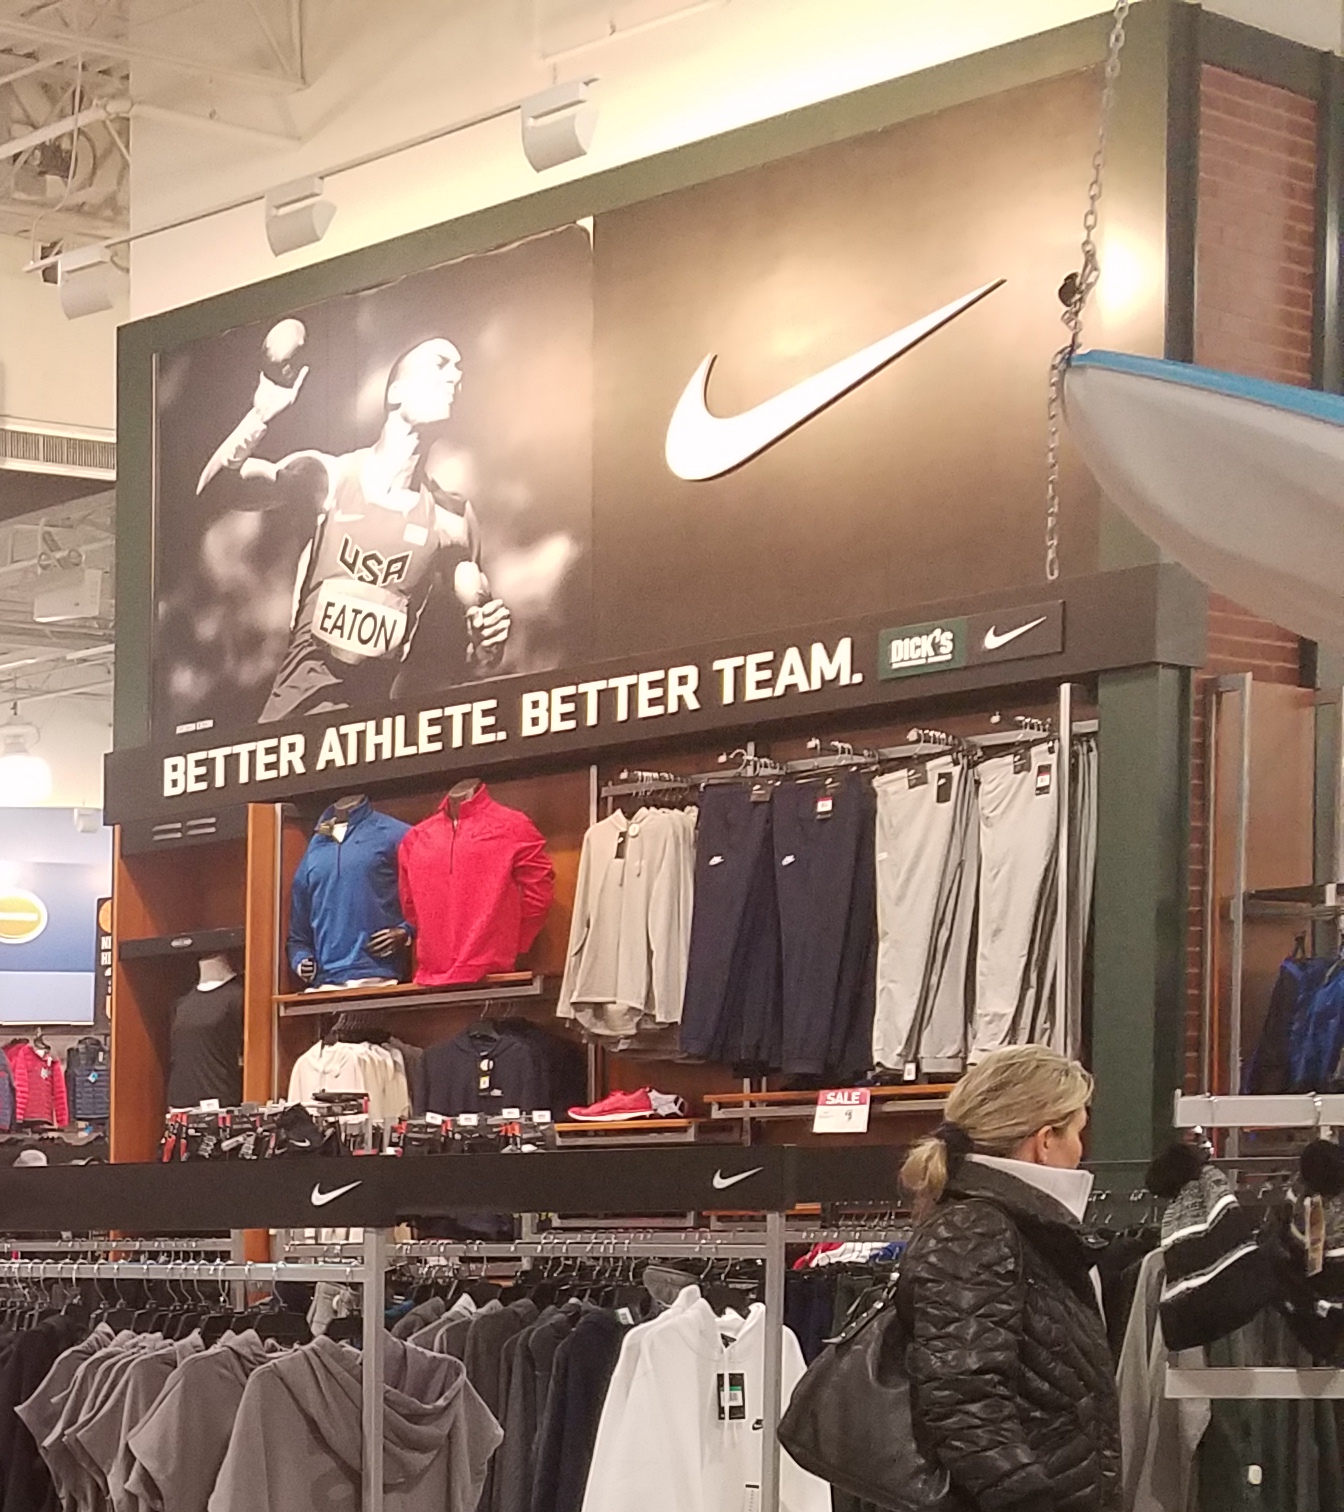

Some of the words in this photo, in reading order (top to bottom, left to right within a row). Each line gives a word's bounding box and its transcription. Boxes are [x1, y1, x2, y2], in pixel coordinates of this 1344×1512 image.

[336, 534, 412, 586] USA
[319, 600, 397, 652] EATON
[889, 628, 954, 663] DICK'S
[163, 732, 306, 798] BETTER
[315, 698, 508, 773] ATHLETE.
[521, 664, 701, 740] BETTER
[712, 637, 864, 706] TEAM.
[825, 1091, 861, 1105] SALE
